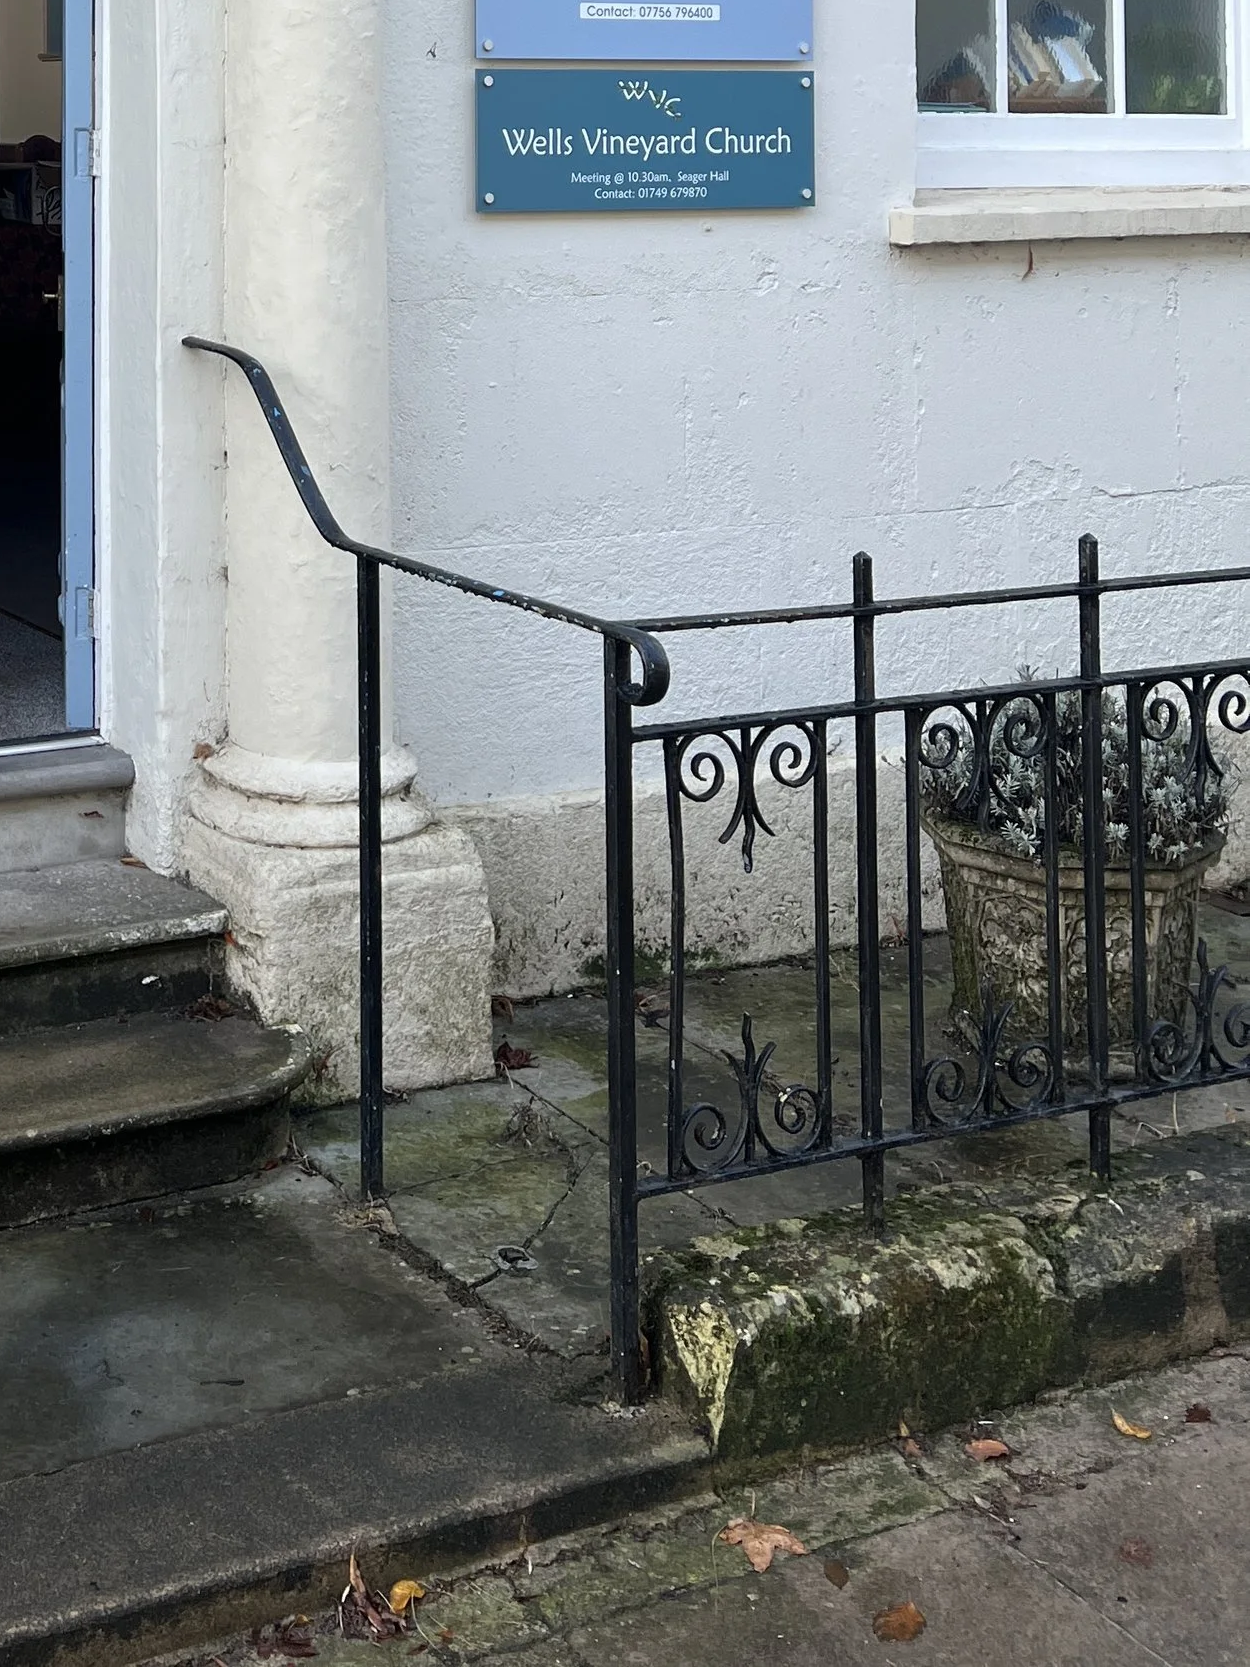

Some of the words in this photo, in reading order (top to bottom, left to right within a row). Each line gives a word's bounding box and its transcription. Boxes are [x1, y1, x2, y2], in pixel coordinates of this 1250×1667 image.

[587, 5, 635, 17] Contact:
[639, 6, 671, 18] 07756
[676, 7, 712, 18] 796400
[503, 128, 572, 155] Wells
[582, 128, 695, 161] Vineyard
[706, 127, 791, 153] Church
[571, 173, 611, 185] Meeting
[614, 173, 624, 184] @
[678, 171, 707, 184] Seager
[710, 170, 729, 181] Hall
[595, 188, 635, 198] Contact:
[638, 187, 667, 198] 01749
[670, 187, 707, 197] 679870
